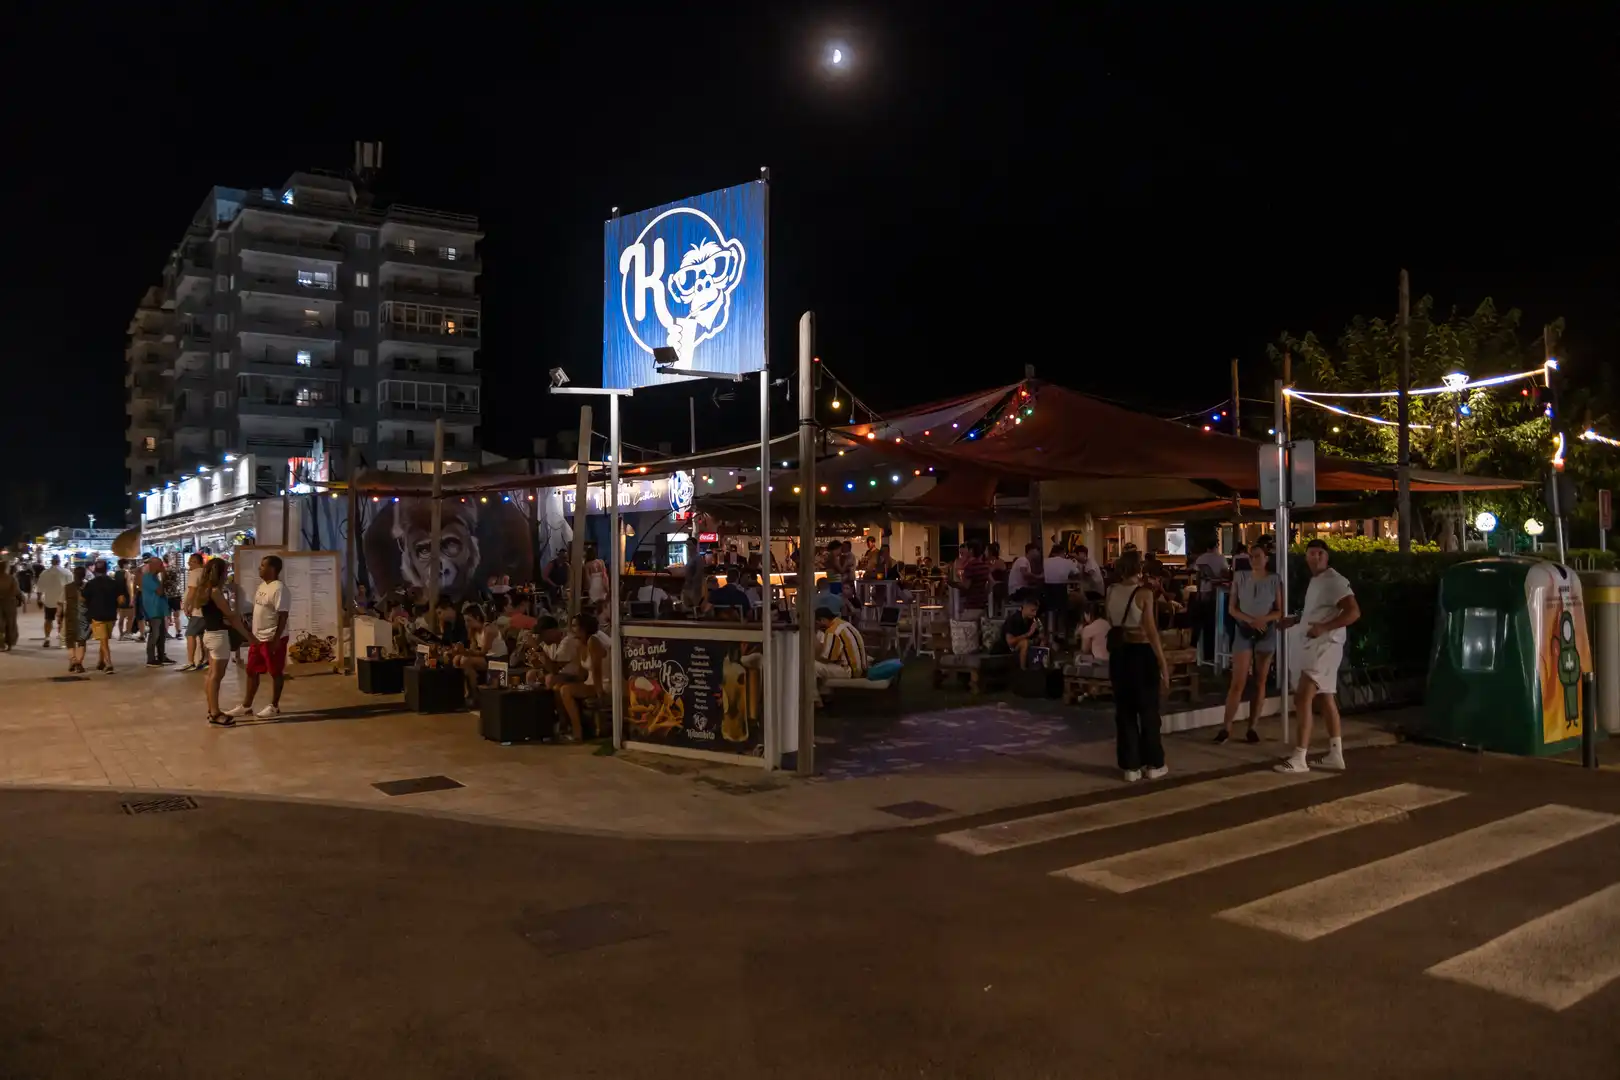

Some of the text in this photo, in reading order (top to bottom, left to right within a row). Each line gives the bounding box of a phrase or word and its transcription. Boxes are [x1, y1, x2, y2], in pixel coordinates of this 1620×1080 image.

[619, 237, 675, 329] K
[648, 641, 668, 654] and
[628, 657, 662, 671] Drinks
